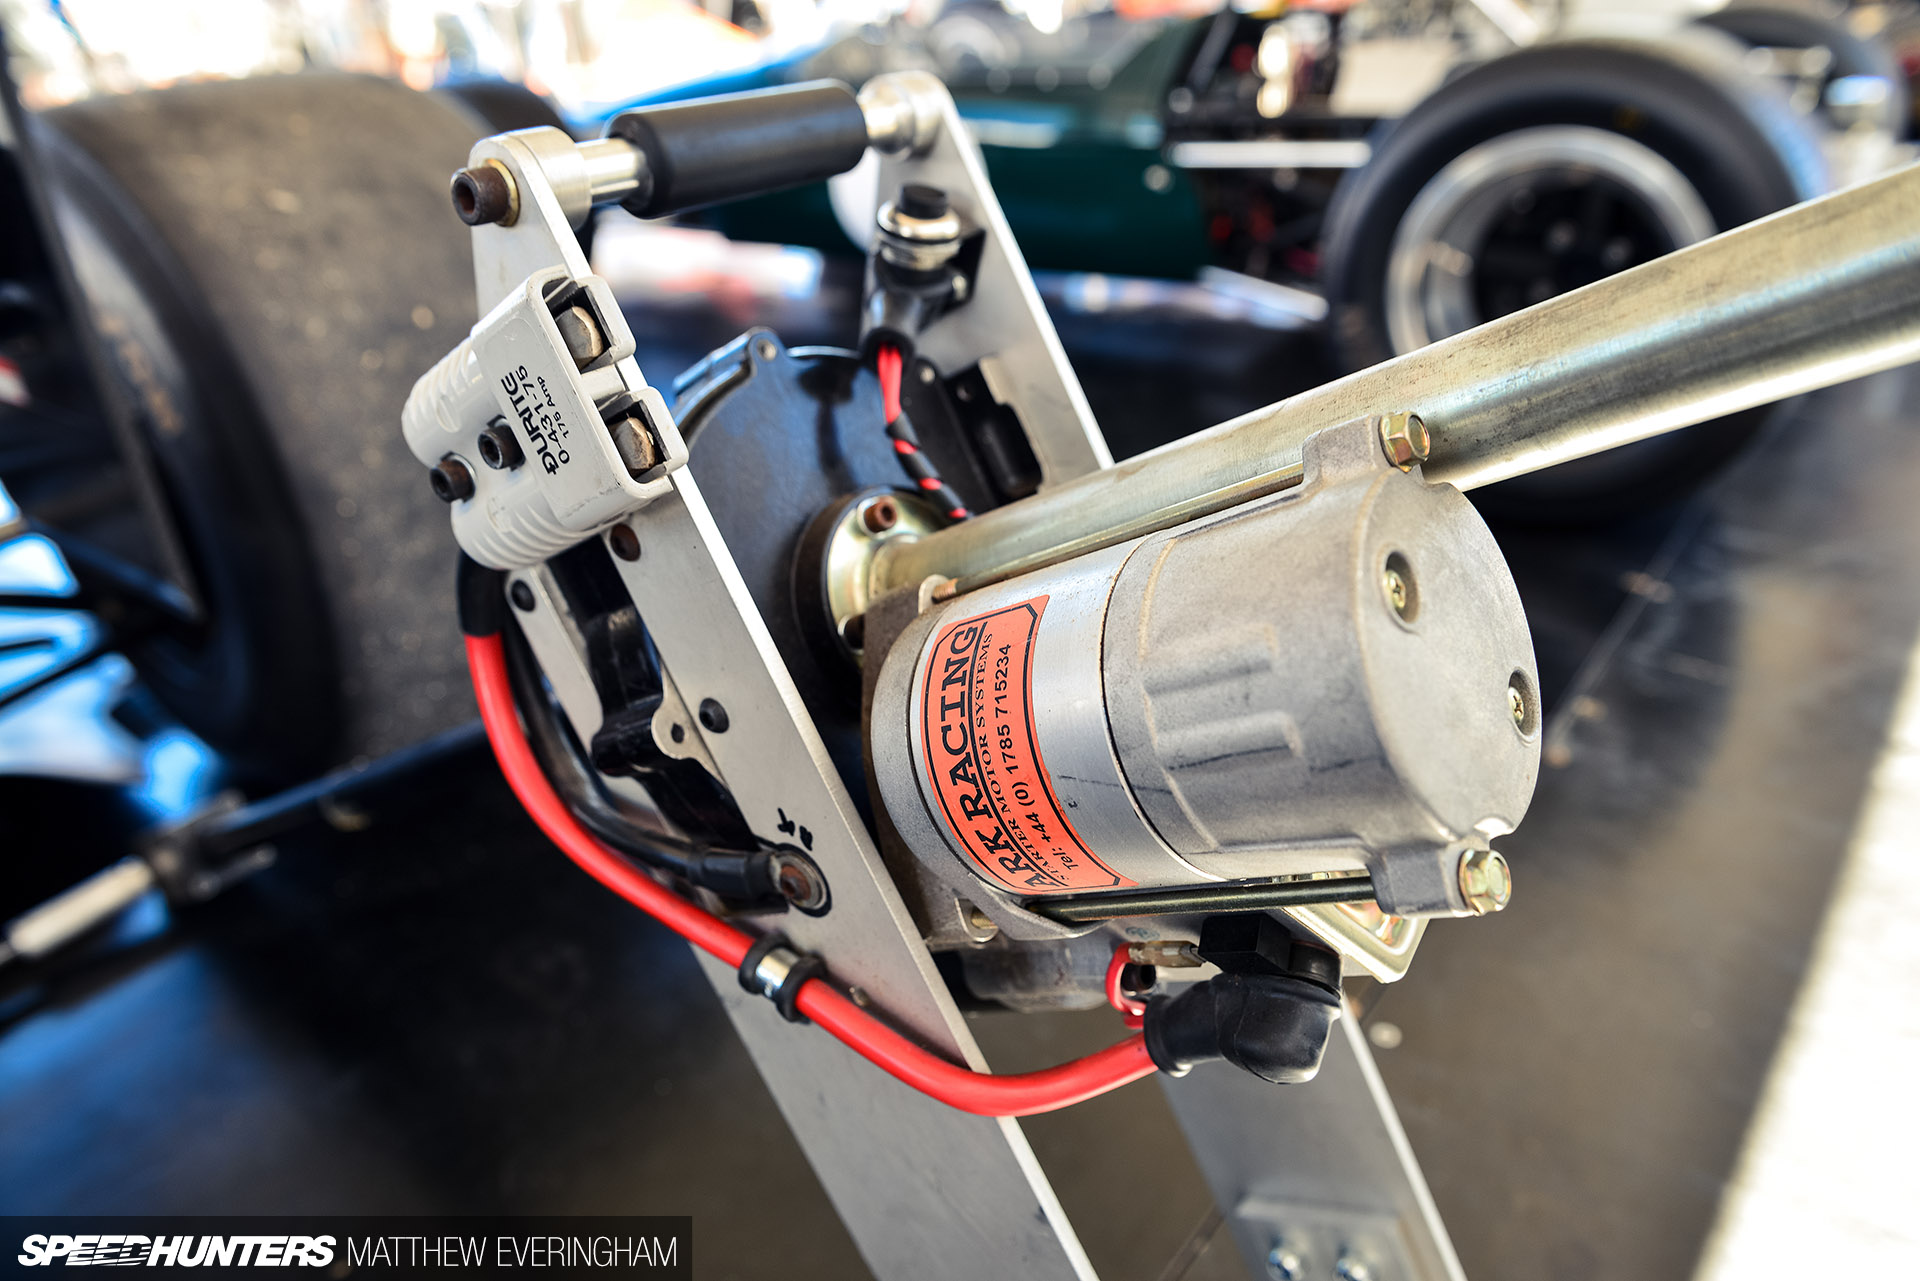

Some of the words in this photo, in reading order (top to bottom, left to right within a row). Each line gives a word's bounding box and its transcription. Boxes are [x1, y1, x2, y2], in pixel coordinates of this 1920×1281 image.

[516, 365, 570, 464] 0-431-75
[537, 376, 556, 407] Amp
[501, 372, 560, 475] DURITE
[553, 412, 570, 439] 175
[973, 633, 993, 728] SYSTEMS
[993, 644, 1012, 718] 715234
[941, 626, 992, 822] RACING
[994, 724, 1019, 774] 1785
[978, 734, 1011, 813] MOTOR
[1013, 781, 1035, 807] (0)
[1025, 813, 1053, 841] +44
[976, 829, 1063, 889] ARK
[1052, 846, 1079, 870] Tel:
